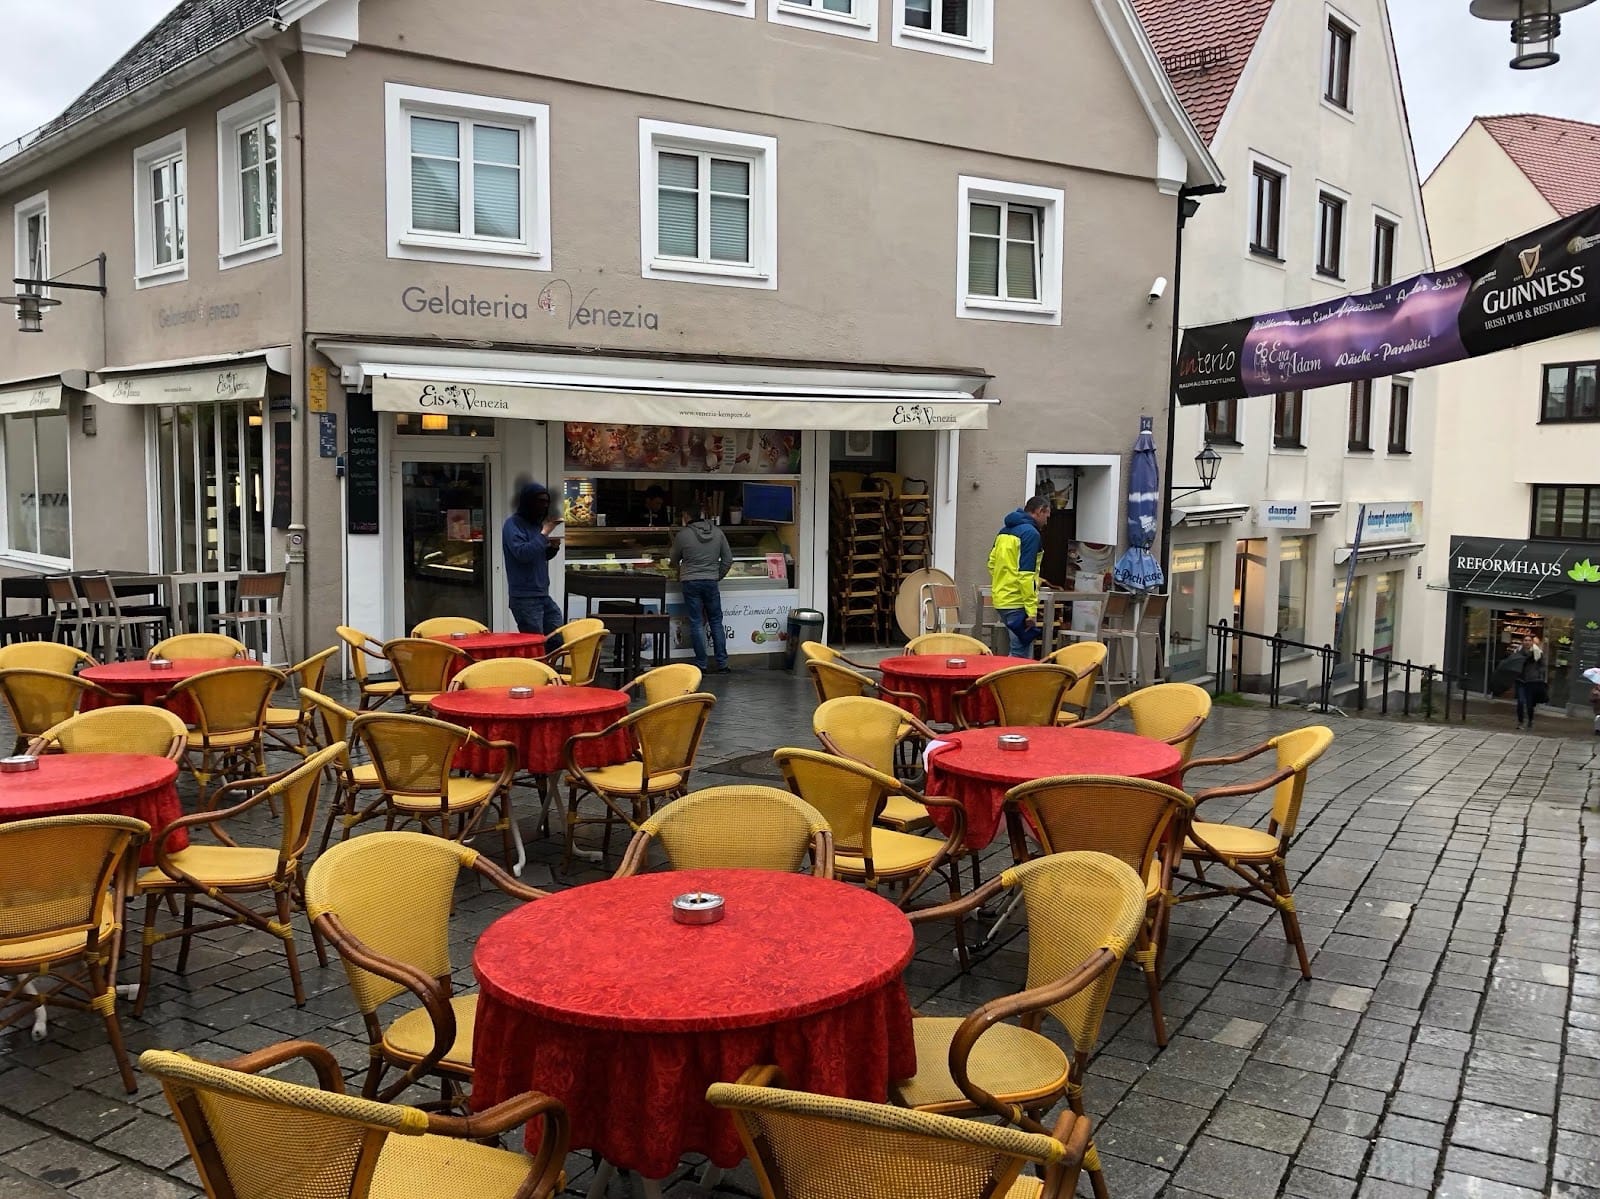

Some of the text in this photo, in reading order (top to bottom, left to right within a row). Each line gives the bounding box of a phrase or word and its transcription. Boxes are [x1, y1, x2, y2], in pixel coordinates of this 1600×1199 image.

[1482, 265, 1585, 315] GUINNESS
[401, 278, 659, 331] Gelateria Venezia
[1484, 292, 1587, 330] IRISH PUB & RESTAURANT
[1269, 340, 1290, 364] Eva
[1281, 351, 1322, 383] Adam
[419, 384, 510, 411] Eis Venezia
[892, 405, 957, 425] Eis Venezia
[1142, 419, 1151, 429] 14
[1367, 509, 1385, 528] dampf
[1456, 556, 1562, 577] REFORMHAUS
